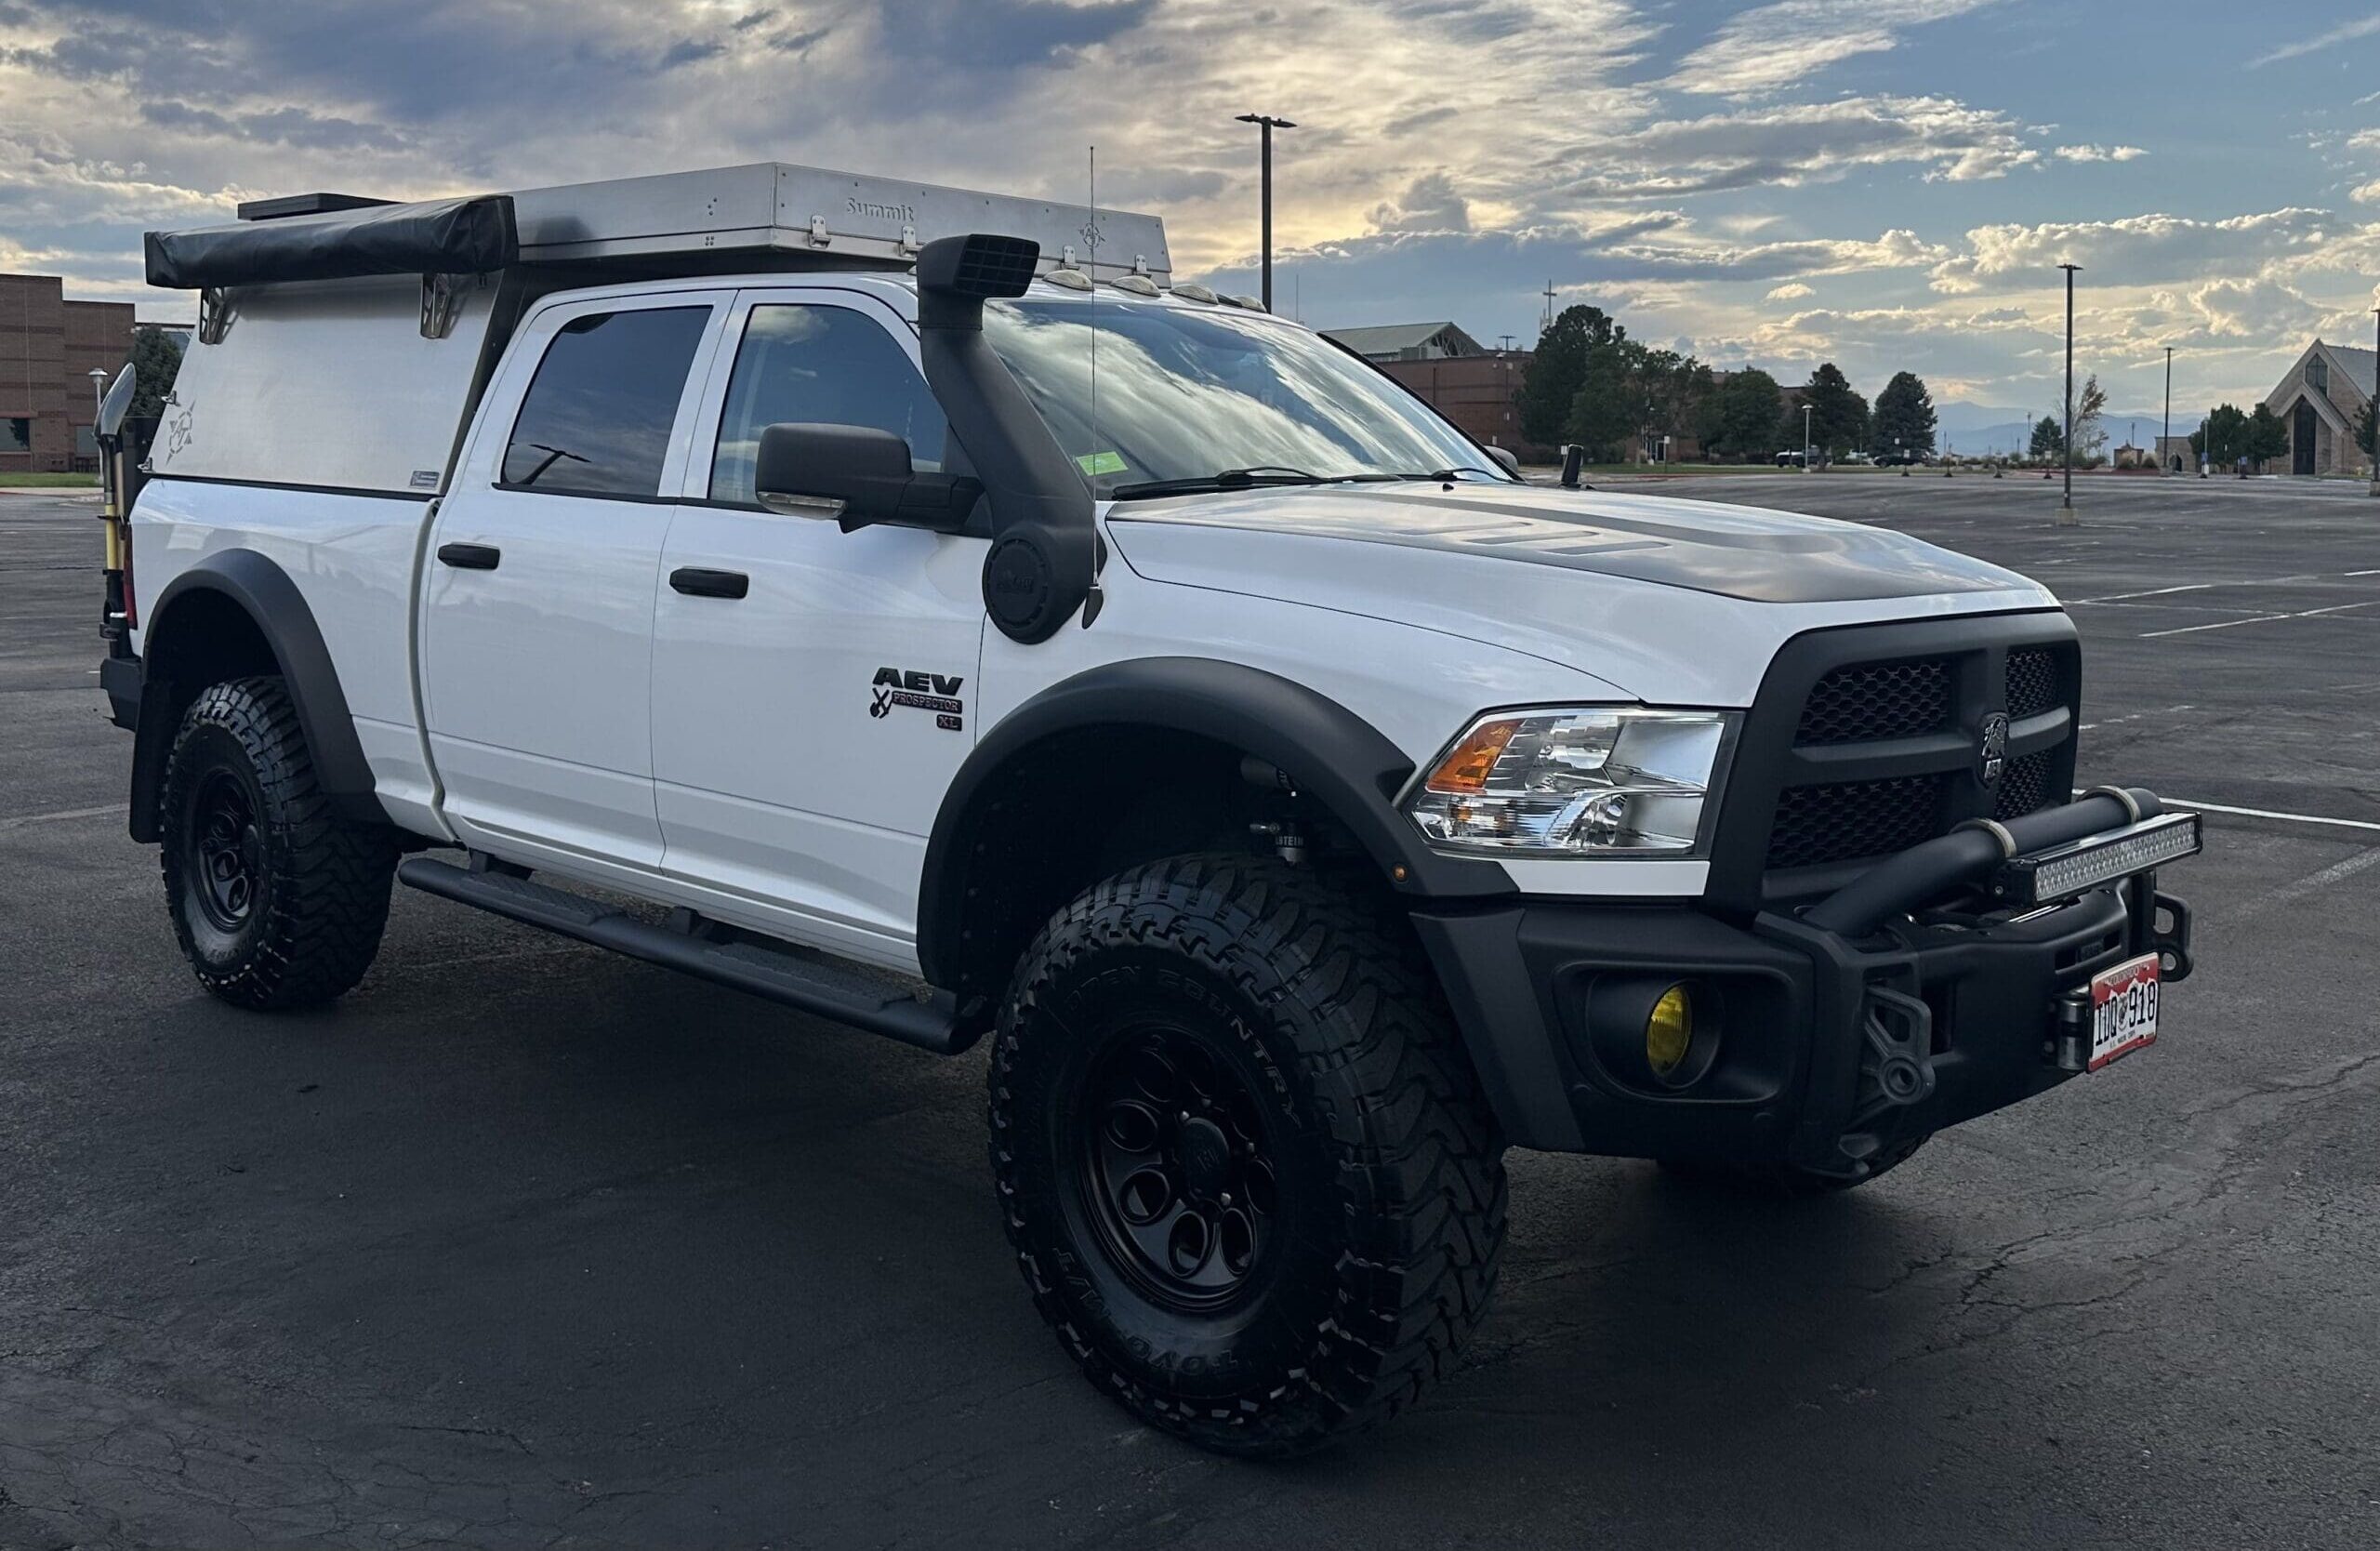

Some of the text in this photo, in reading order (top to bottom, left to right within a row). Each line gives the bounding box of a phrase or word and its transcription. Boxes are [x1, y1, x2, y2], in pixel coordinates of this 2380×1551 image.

[847, 196, 914, 222] Summit
[872, 667, 964, 696] AEV
[893, 692, 959, 712] PROSPECTOR
[938, 715, 959, 730] XL
[2129, 981, 2156, 1027] 918
